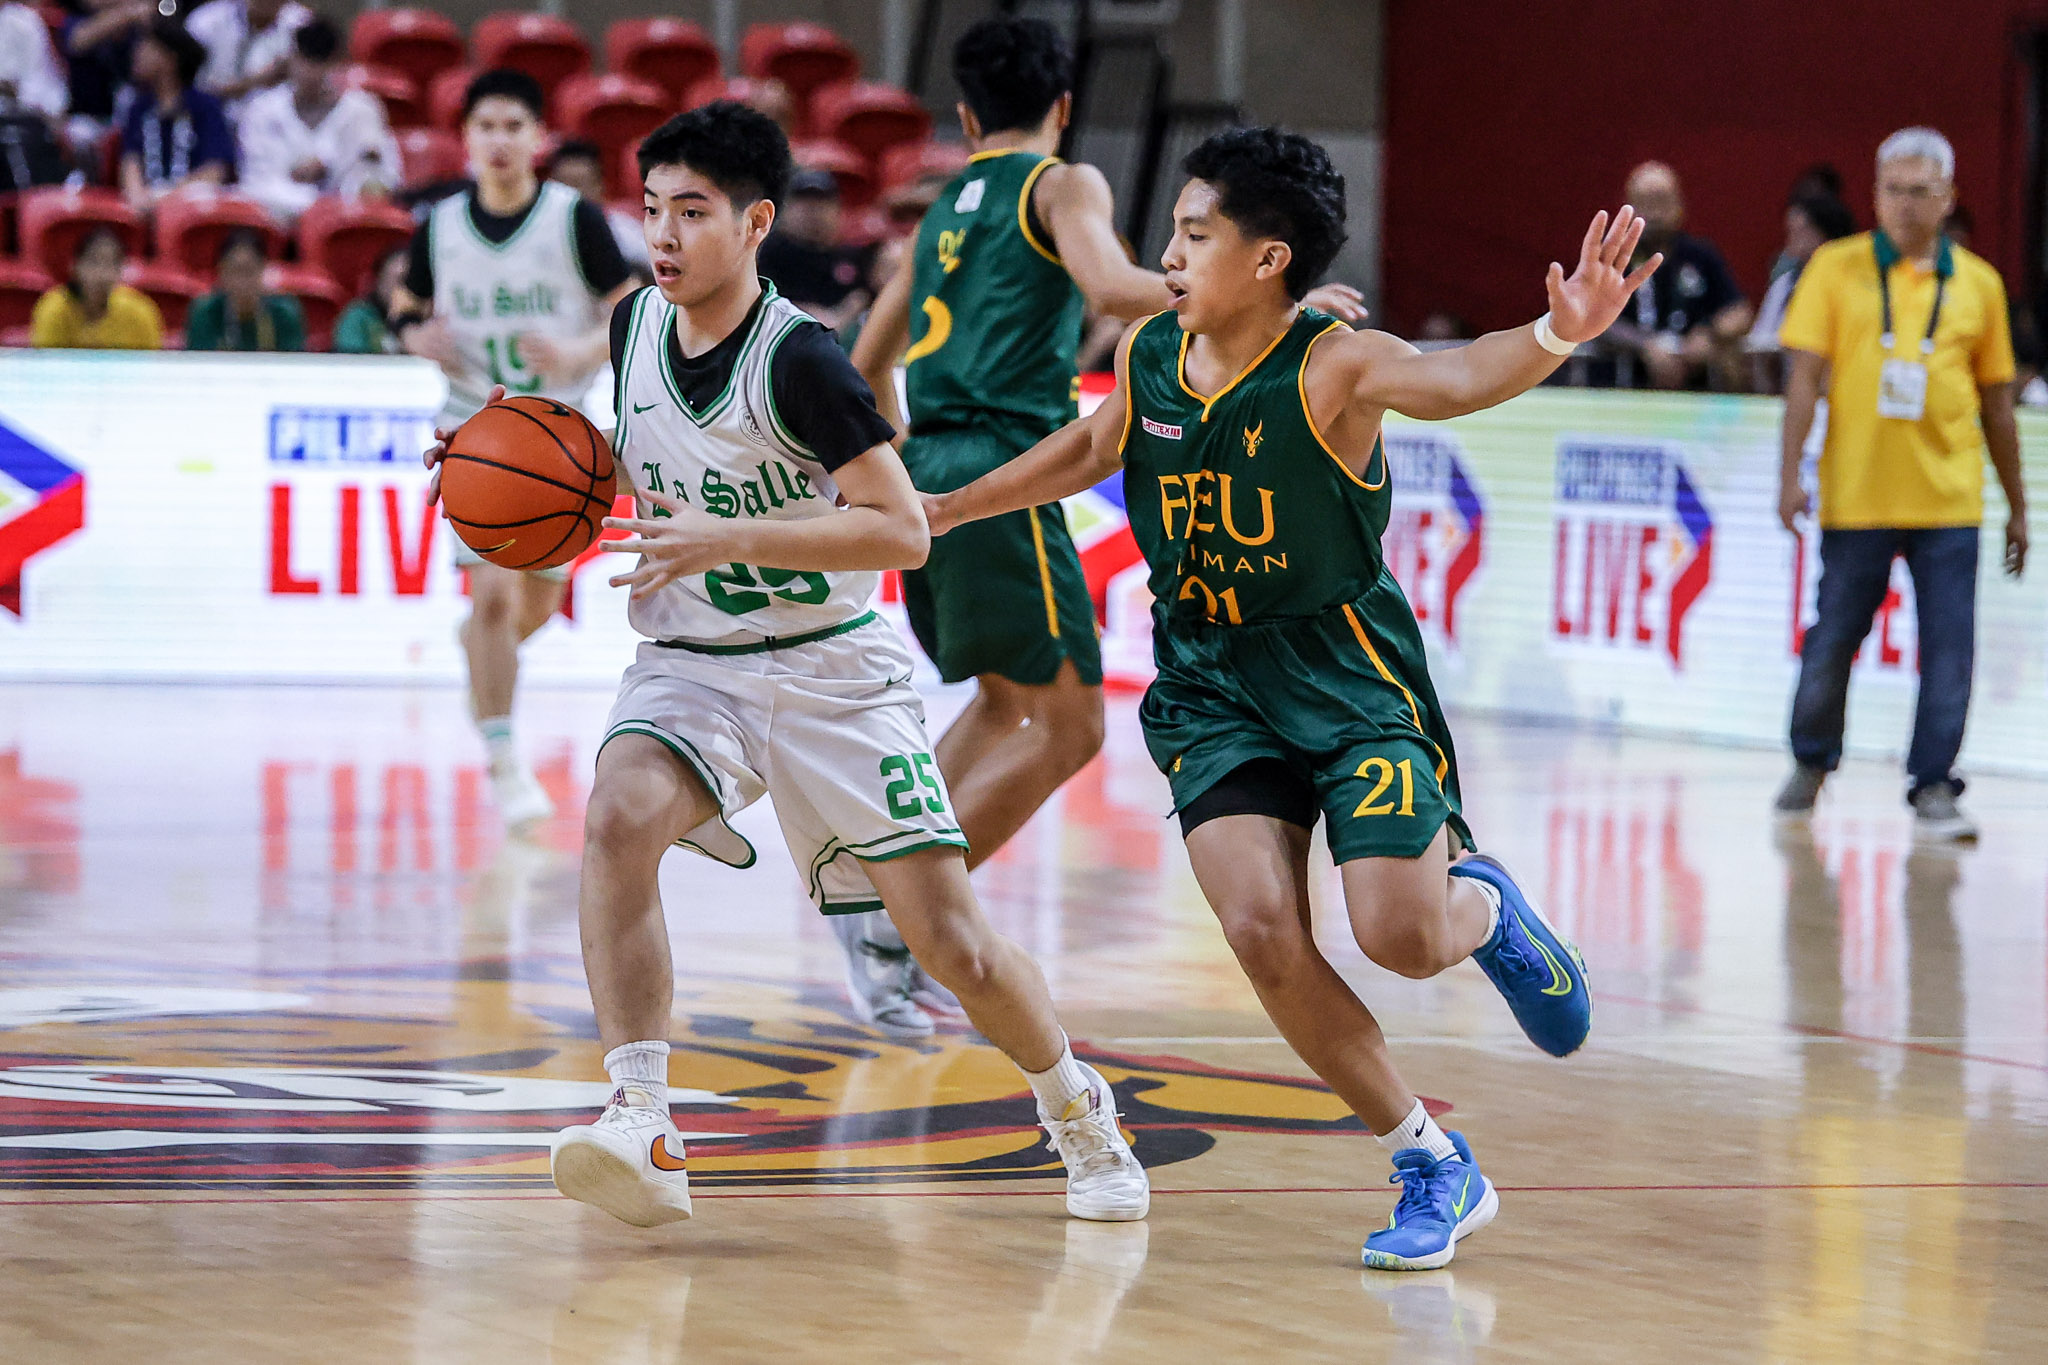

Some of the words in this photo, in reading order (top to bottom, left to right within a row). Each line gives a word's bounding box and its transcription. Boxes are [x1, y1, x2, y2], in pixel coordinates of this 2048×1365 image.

[701, 460, 816, 518] Salle
[1158, 468, 1275, 546] FEU
[269, 483, 473, 595] LIV
[1556, 519, 1658, 640] LIVE
[879, 752, 945, 820] 25
[1352, 756, 1416, 818] 21
